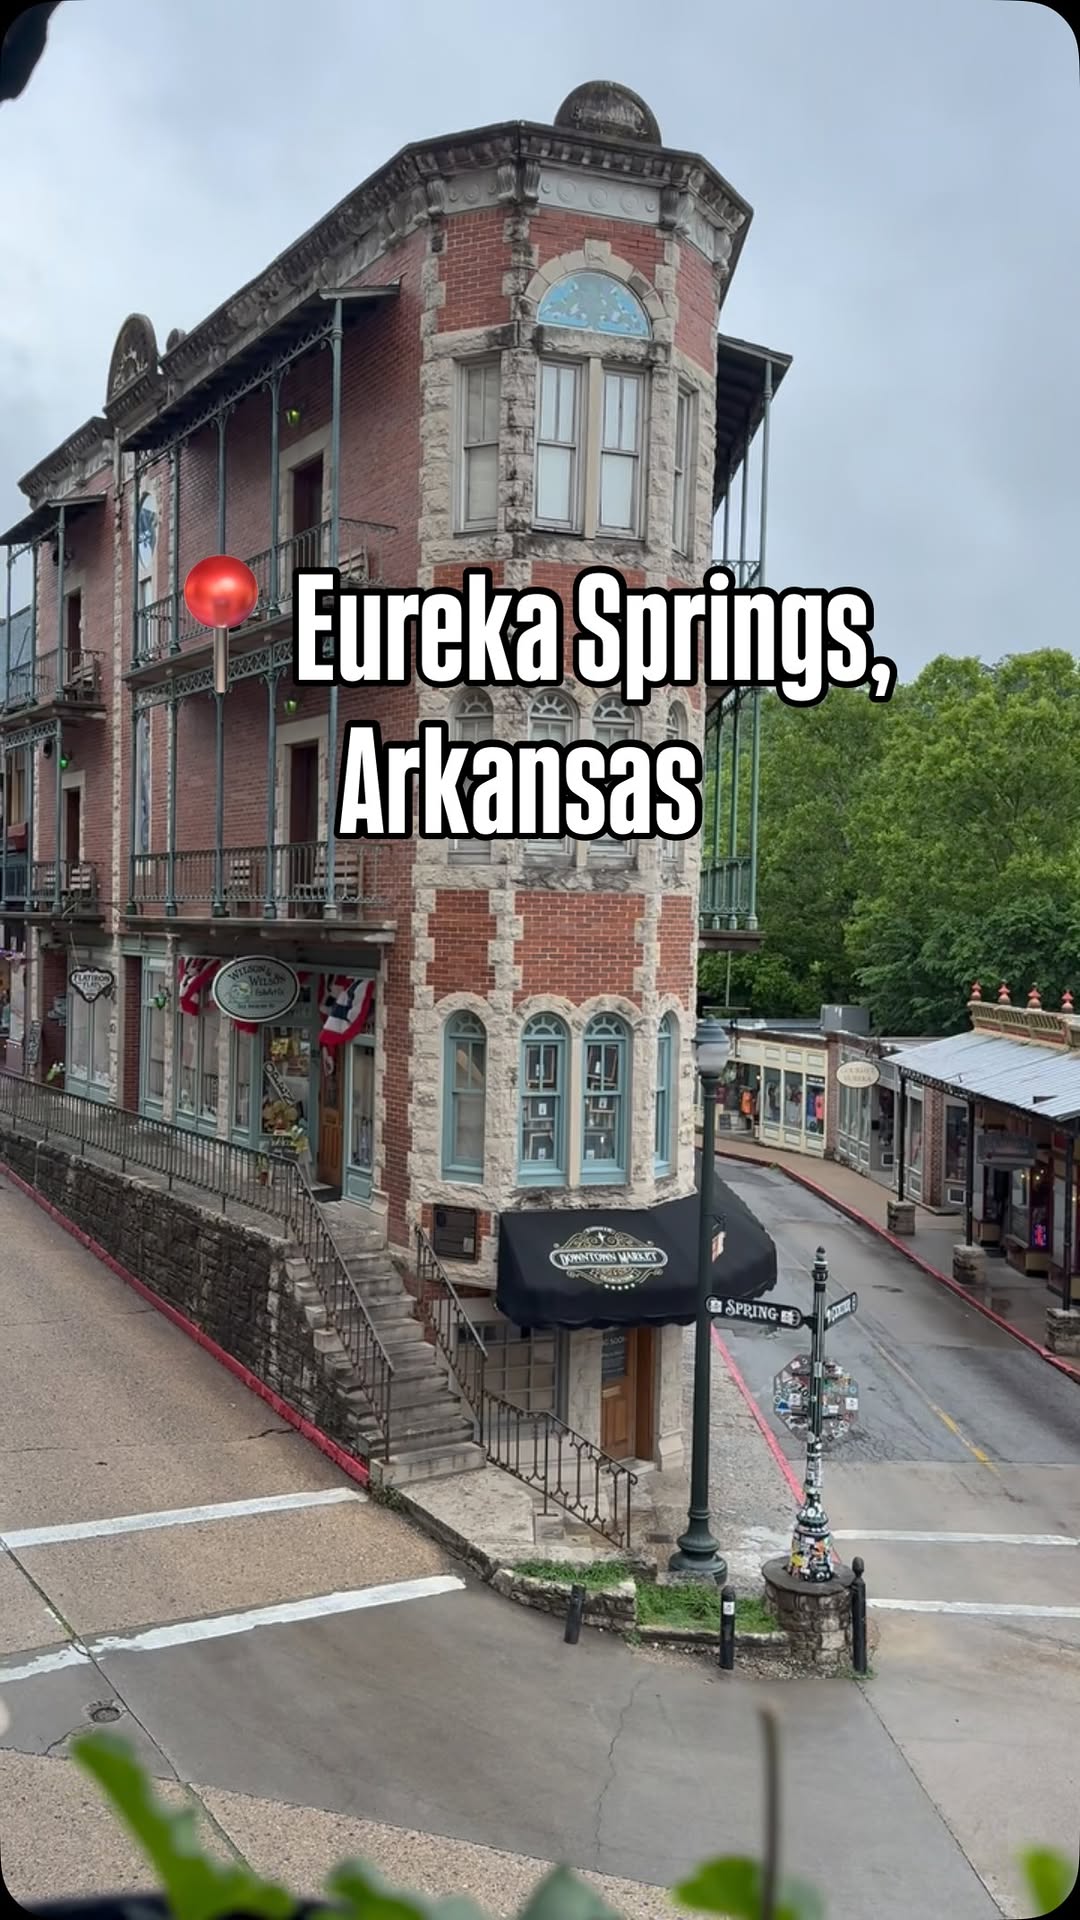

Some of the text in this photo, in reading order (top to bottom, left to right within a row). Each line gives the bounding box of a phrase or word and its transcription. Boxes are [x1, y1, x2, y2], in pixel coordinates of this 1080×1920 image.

[72, 974, 110, 984] FLATIRON
[228, 965, 265, 980] WILSON
[249, 975, 286, 986] WILSON
[264, 1062, 296, 1106] OPEN
[560, 1252, 657, 1265] DOWNTOWN MARKET
[725, 1299, 779, 1321] SPRING
